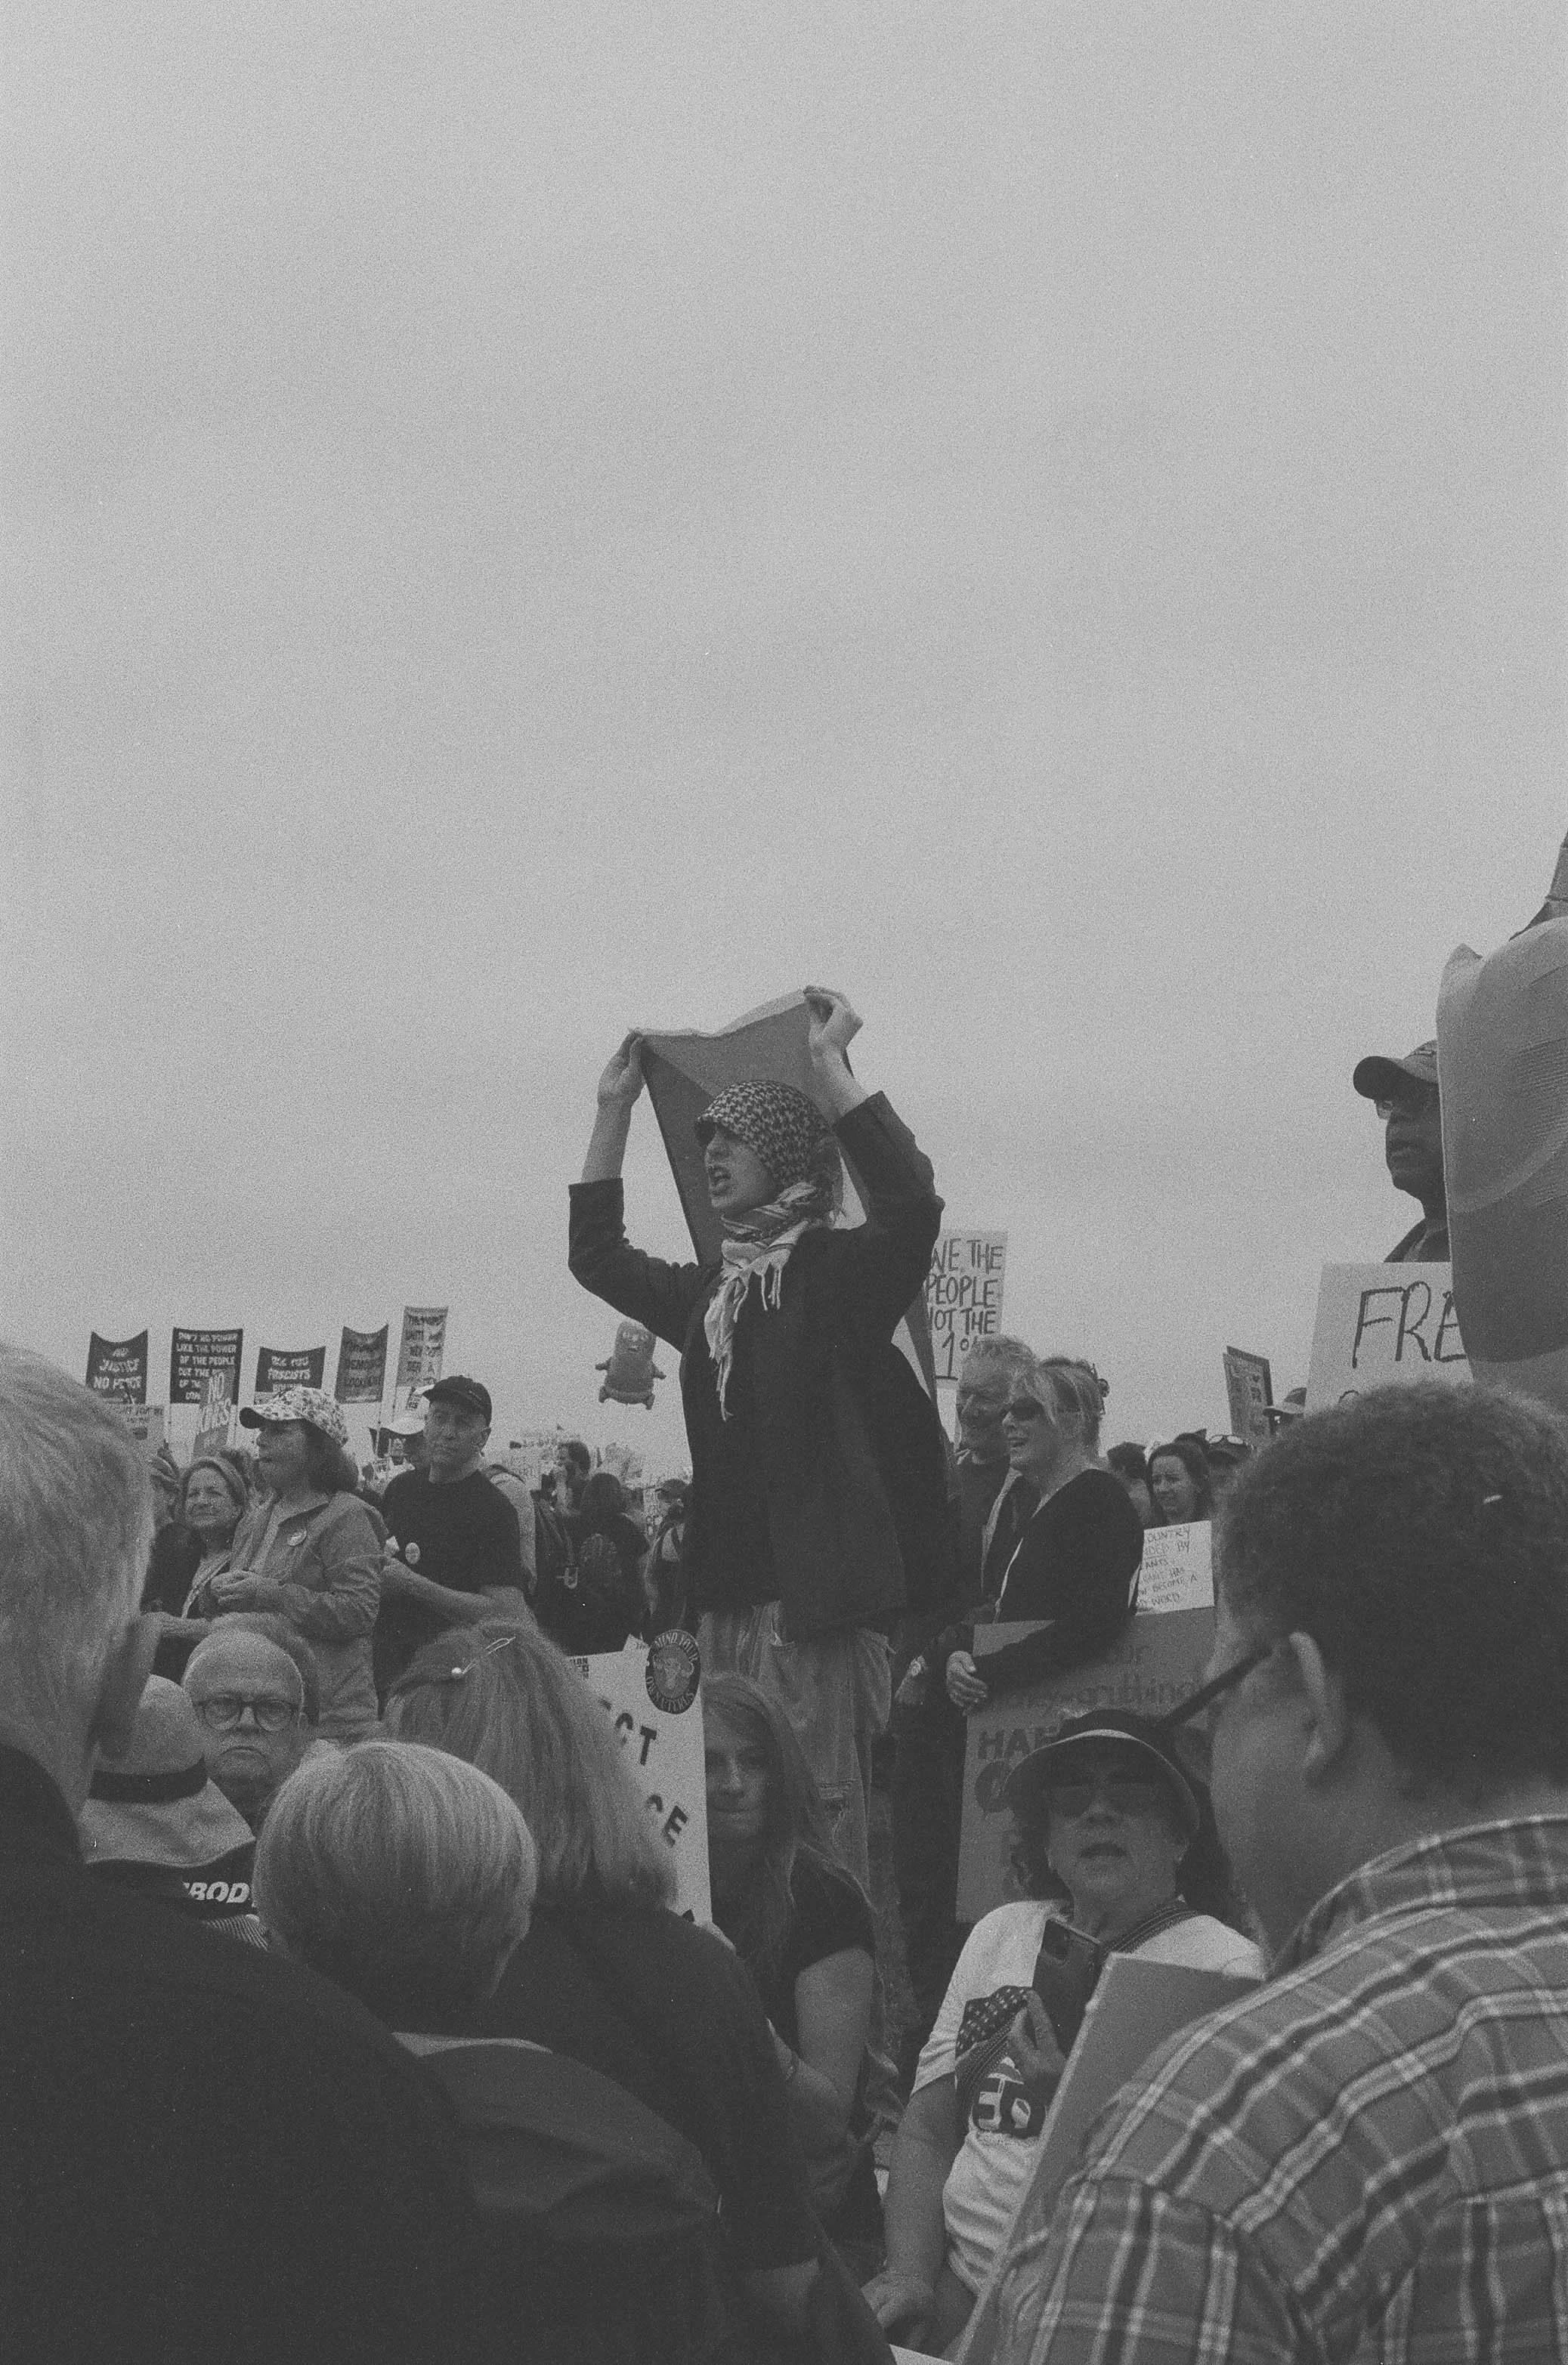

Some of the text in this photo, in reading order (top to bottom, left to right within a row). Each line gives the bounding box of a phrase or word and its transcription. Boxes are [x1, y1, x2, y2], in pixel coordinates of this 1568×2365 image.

[966, 1239, 1004, 1275] THE
[925, 1273, 998, 1309] PEOPLE
[960, 1308, 997, 1335] THE
[1352, 1281, 1467, 1369] FRE
[93, 1375, 110, 1390] NO
[1147, 1527, 1190, 1542] OUNTRY
